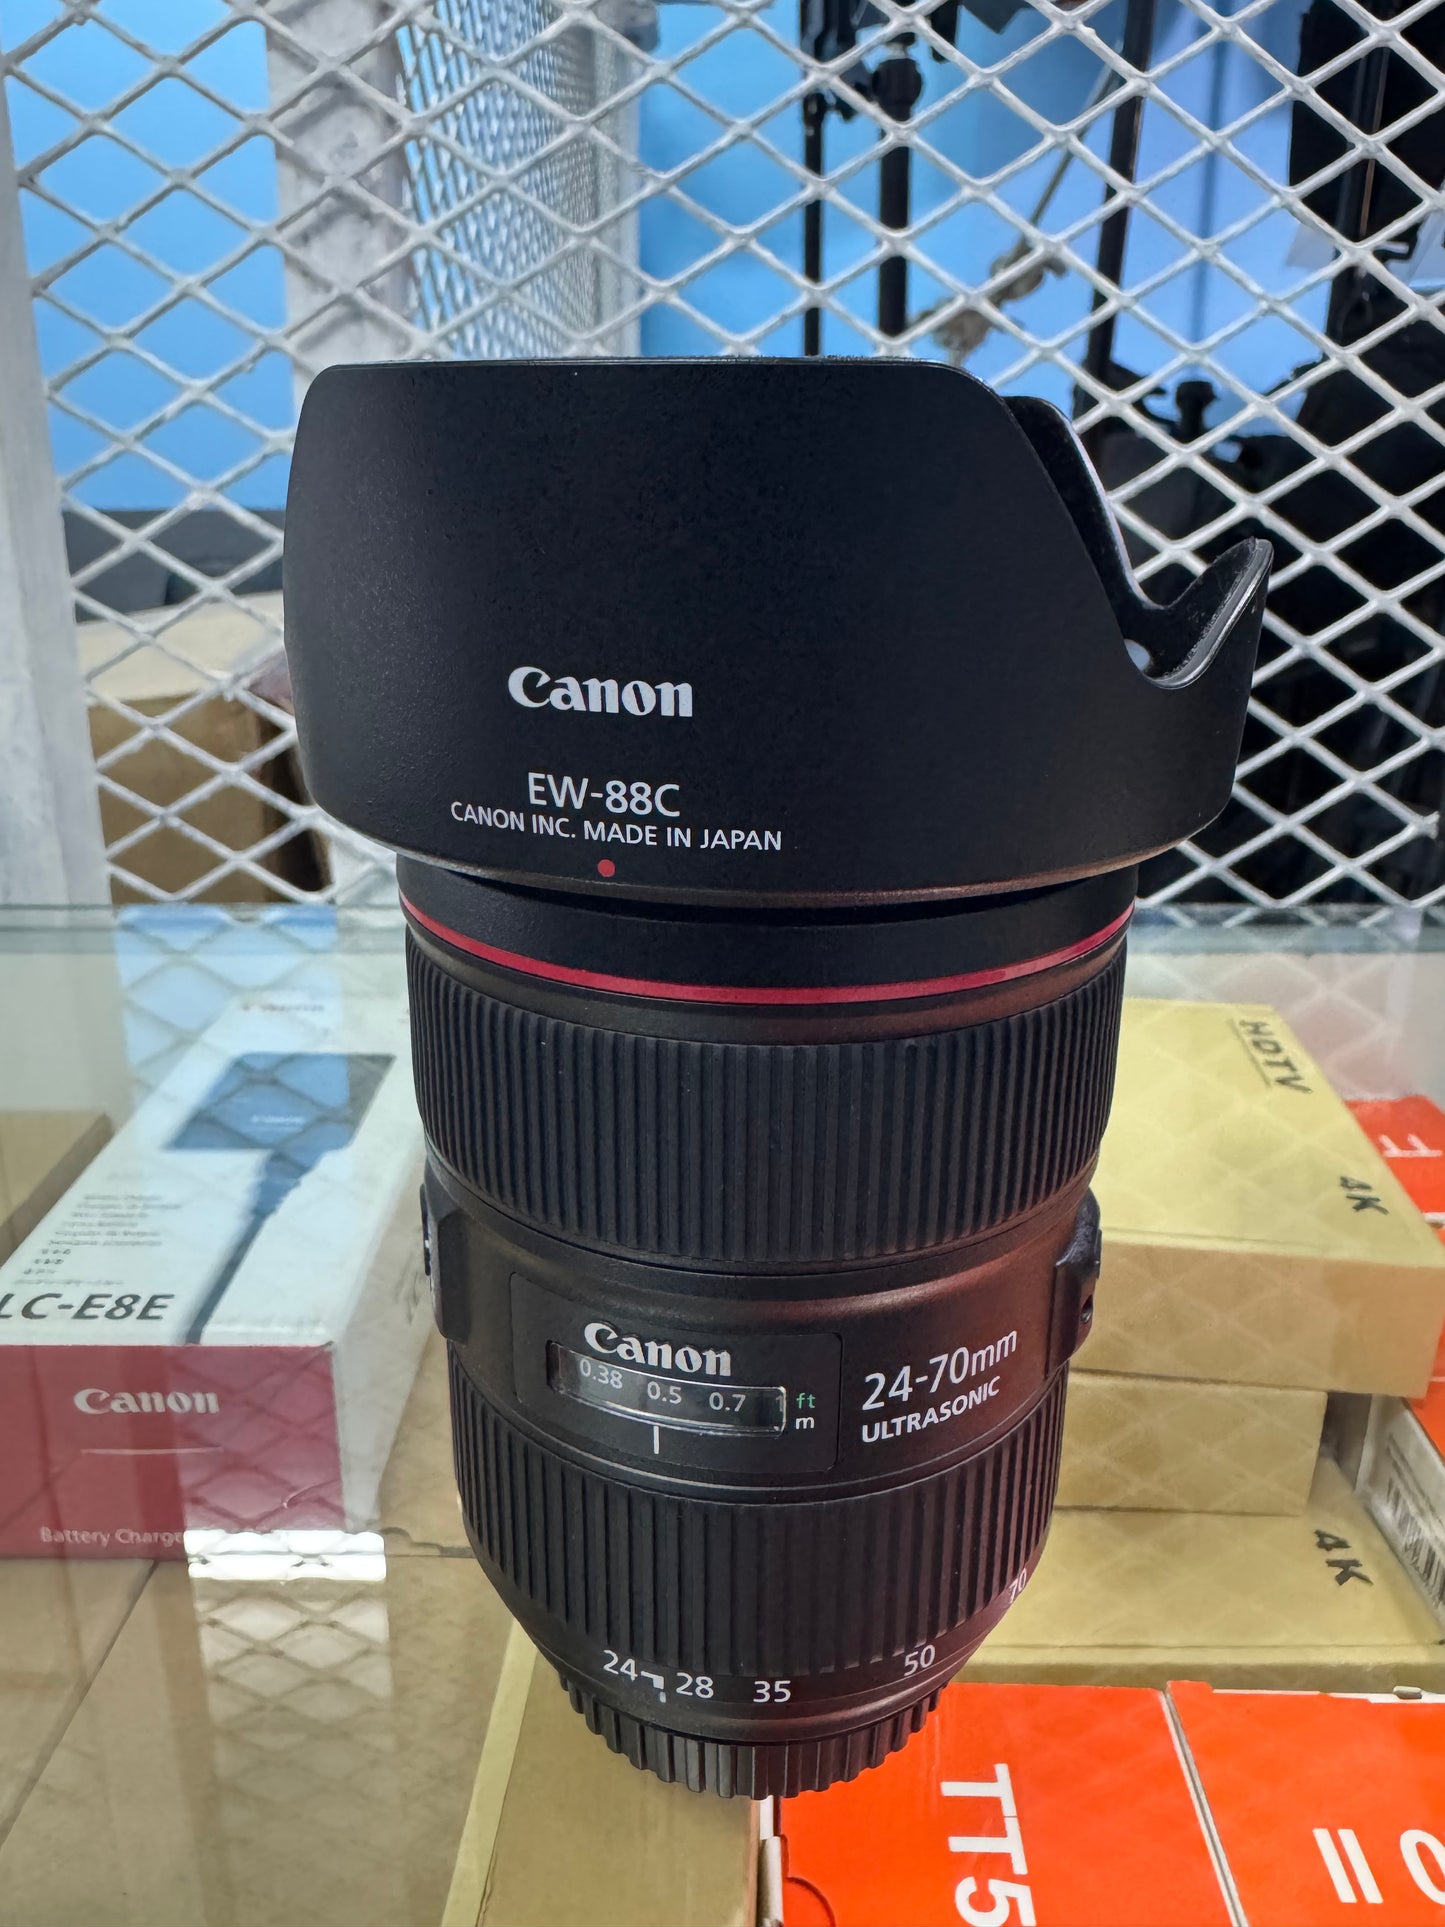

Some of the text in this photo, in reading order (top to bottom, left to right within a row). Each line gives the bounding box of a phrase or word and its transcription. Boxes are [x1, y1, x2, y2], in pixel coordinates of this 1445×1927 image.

[508, 666, 693, 717] Canon
[528, 772, 680, 817] EW-88C
[450, 801, 782, 850] CANON INC. MADE IN JAPAN
[1339, 1176, 1390, 1215] 4K
[0, 1292, 175, 1320] LC-E8E
[583, 1322, 731, 1376] Canon
[862, 1330, 1017, 1411] 24-70mm
[74, 1388, 219, 1414] Canon
[580, 1358, 623, 1389] 0.38
[647, 1381, 682, 1404] 0.5
[709, 1392, 746, 1412] 0.7
[797, 1392, 816, 1409] ft
[862, 1375, 1001, 1443] ULTRASONIC
[795, 1416, 815, 1430] m
[40, 1527, 184, 1547] Battery Charge
[1314, 1529, 1373, 1586] 4K
[603, 1567, 1028, 1703] 24 28 35 50 70
